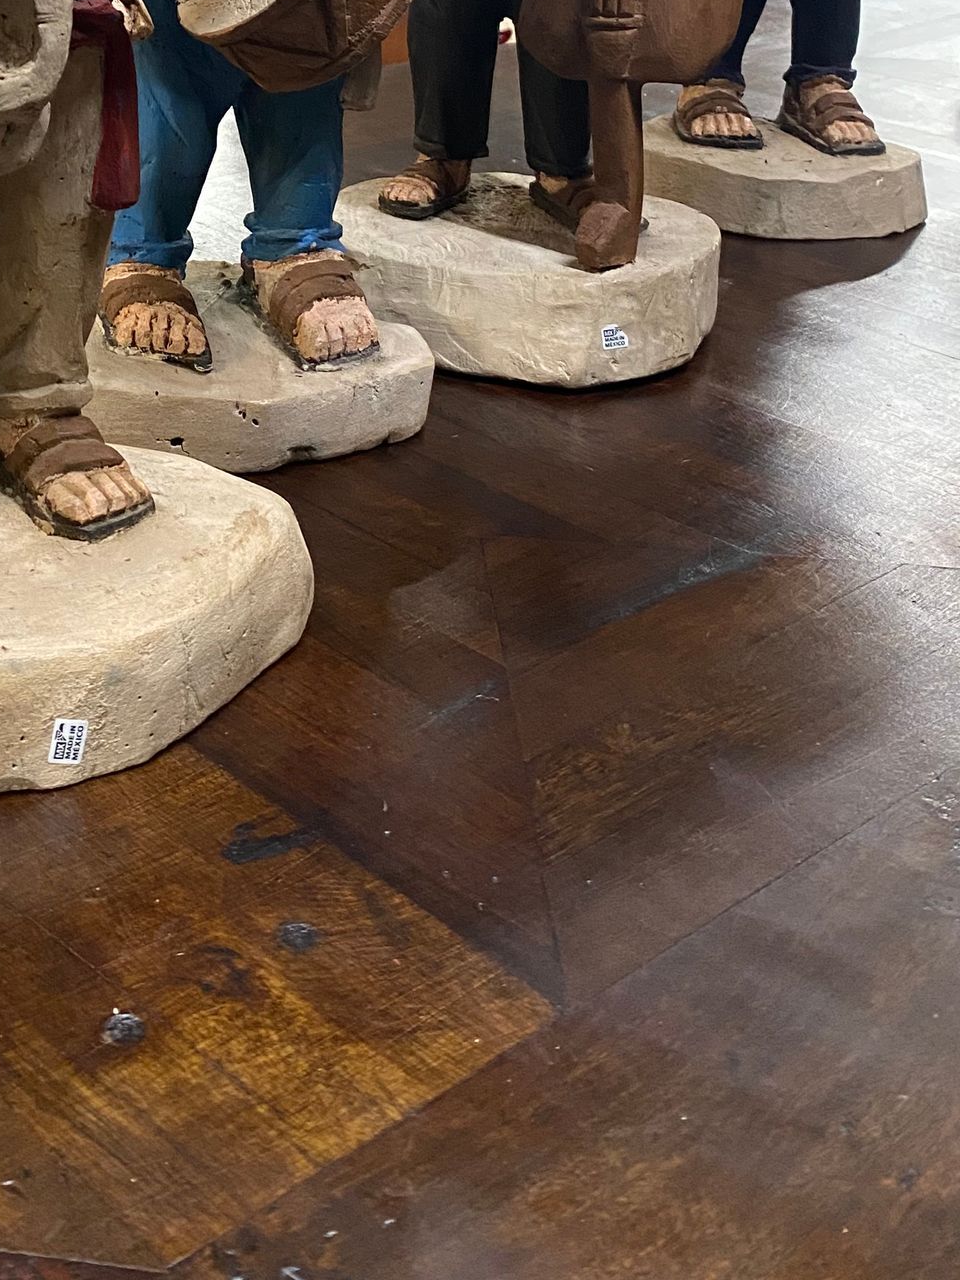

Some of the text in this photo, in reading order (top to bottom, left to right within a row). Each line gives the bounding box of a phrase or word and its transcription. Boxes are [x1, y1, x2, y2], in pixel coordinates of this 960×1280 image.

[54, 742, 66, 759] MX
[65, 725, 76, 759] MADE IN
